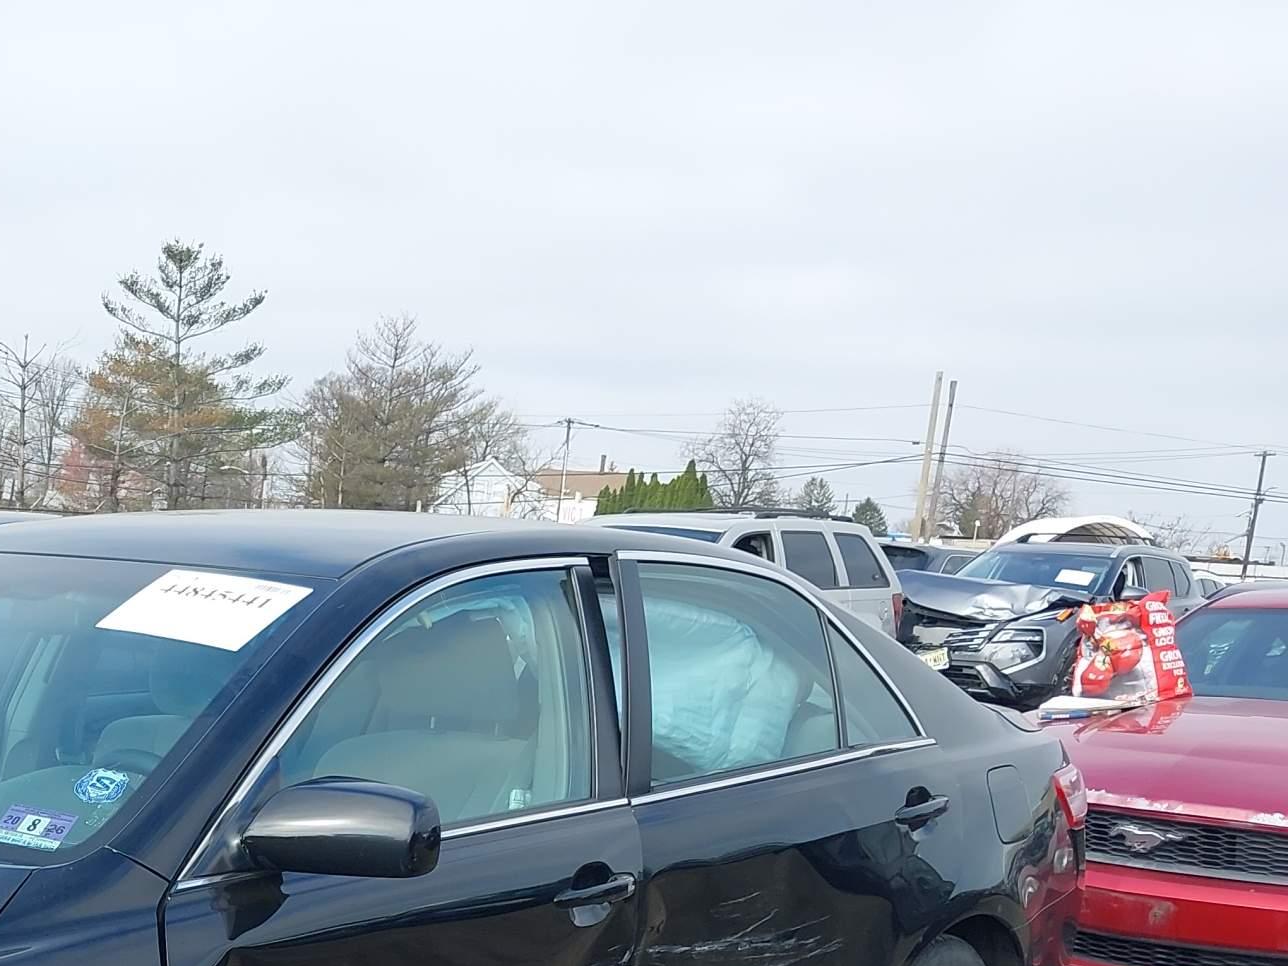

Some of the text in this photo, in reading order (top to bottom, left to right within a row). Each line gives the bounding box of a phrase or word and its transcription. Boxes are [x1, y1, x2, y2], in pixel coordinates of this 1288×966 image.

[160, 584, 272, 609] 44845441
[3, 815, 66, 835] 20 8 26
